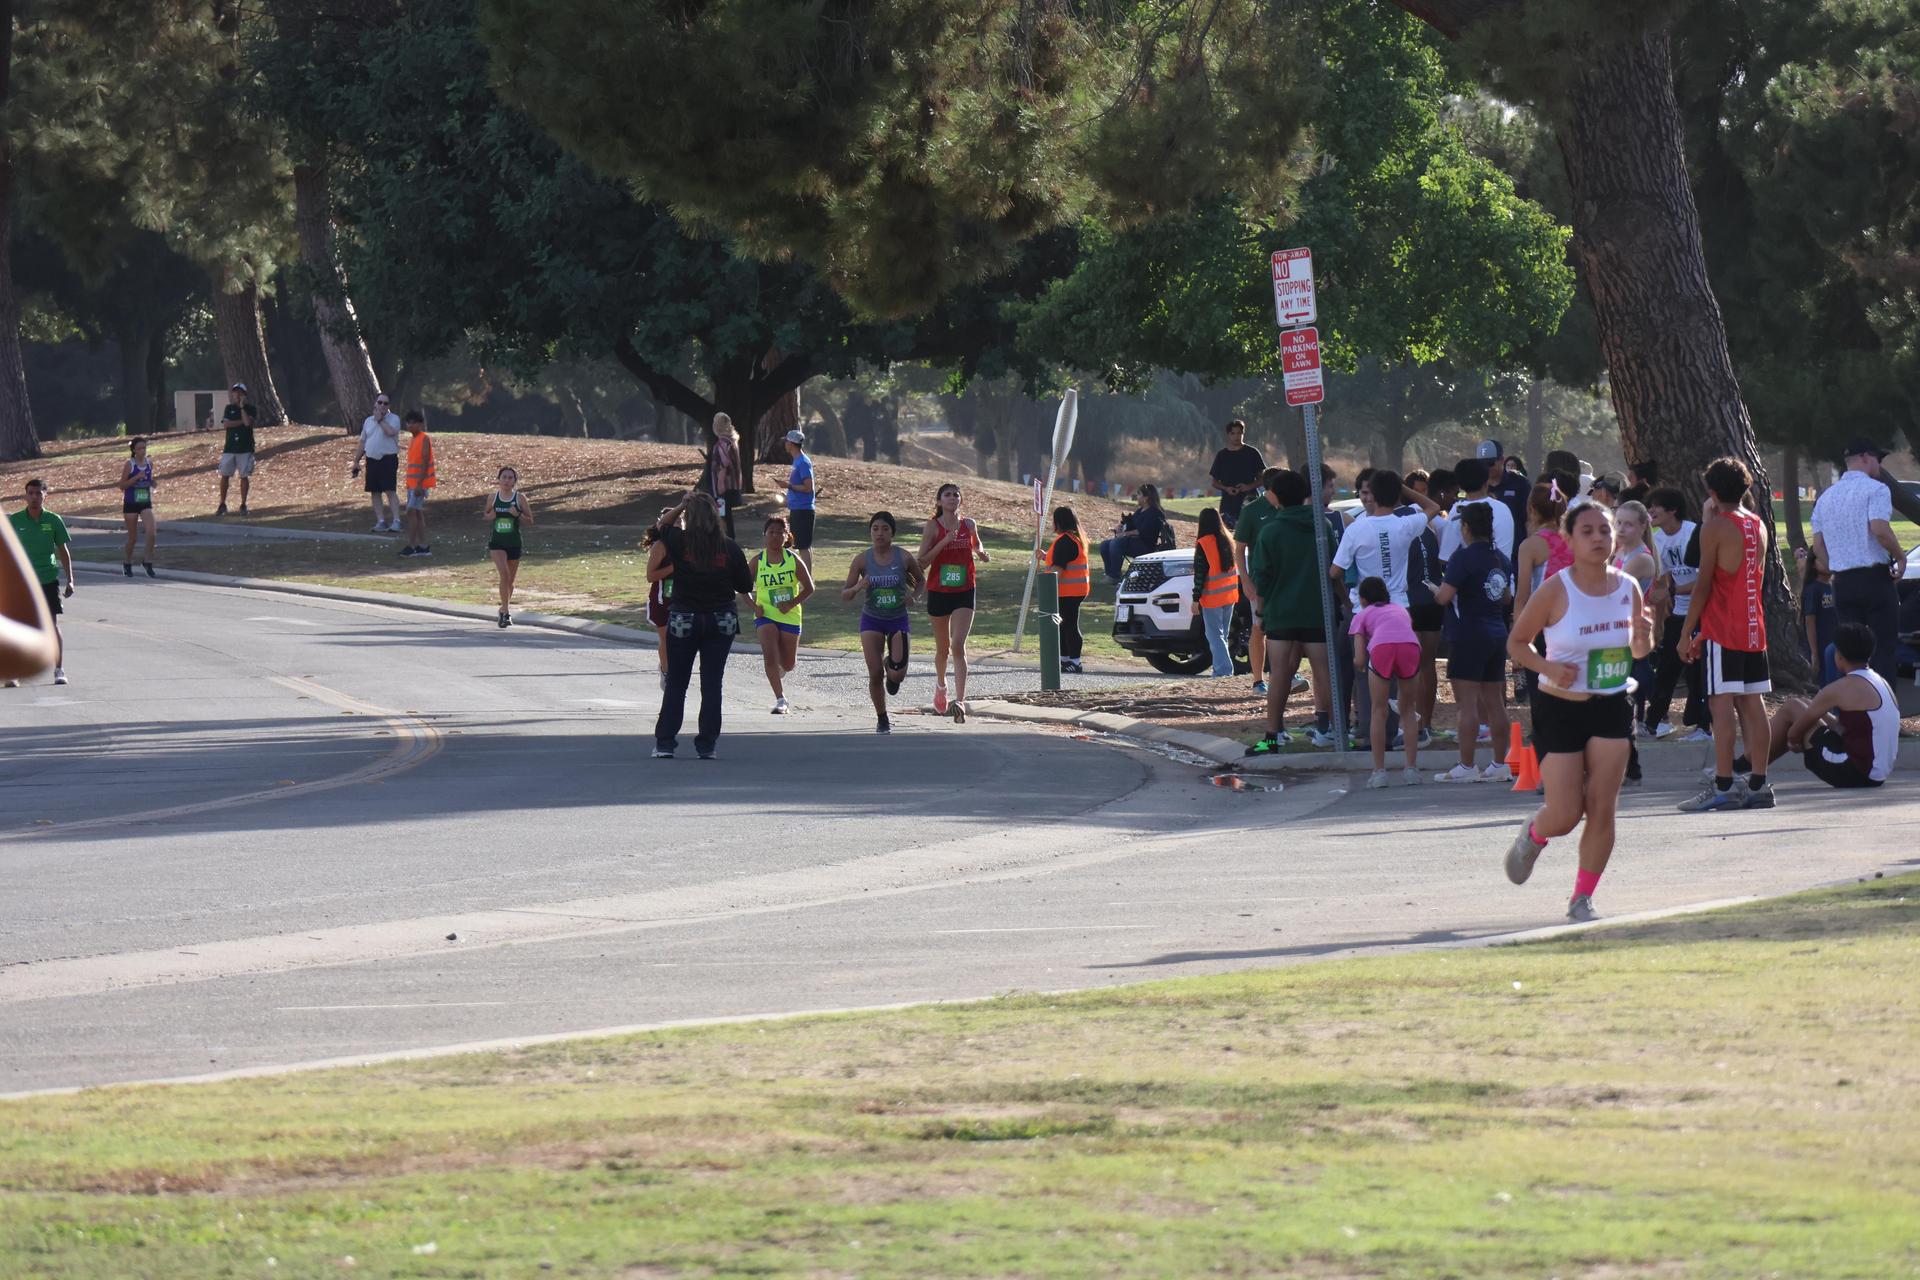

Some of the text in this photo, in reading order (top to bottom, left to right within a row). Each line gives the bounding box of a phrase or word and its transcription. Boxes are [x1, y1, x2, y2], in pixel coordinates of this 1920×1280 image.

[1274, 250, 1307, 261] TOW-AWAY
[1274, 261, 1289, 279] NO
[1277, 278, 1311, 297] STOPPING
[1281, 297, 1311, 310] ANY TIME
[1292, 335, 1305, 344] NO
[1283, 342, 1317, 355] PARKING
[1295, 353, 1306, 361] ON
[1291, 360, 1312, 369] LAWN
[760, 570, 794, 587] TAFT
[946, 572, 960, 581] 285
[876, 595, 897, 605] 2034
[1579, 622, 1611, 636] TULARE
[1596, 661, 1628, 679] 1940
